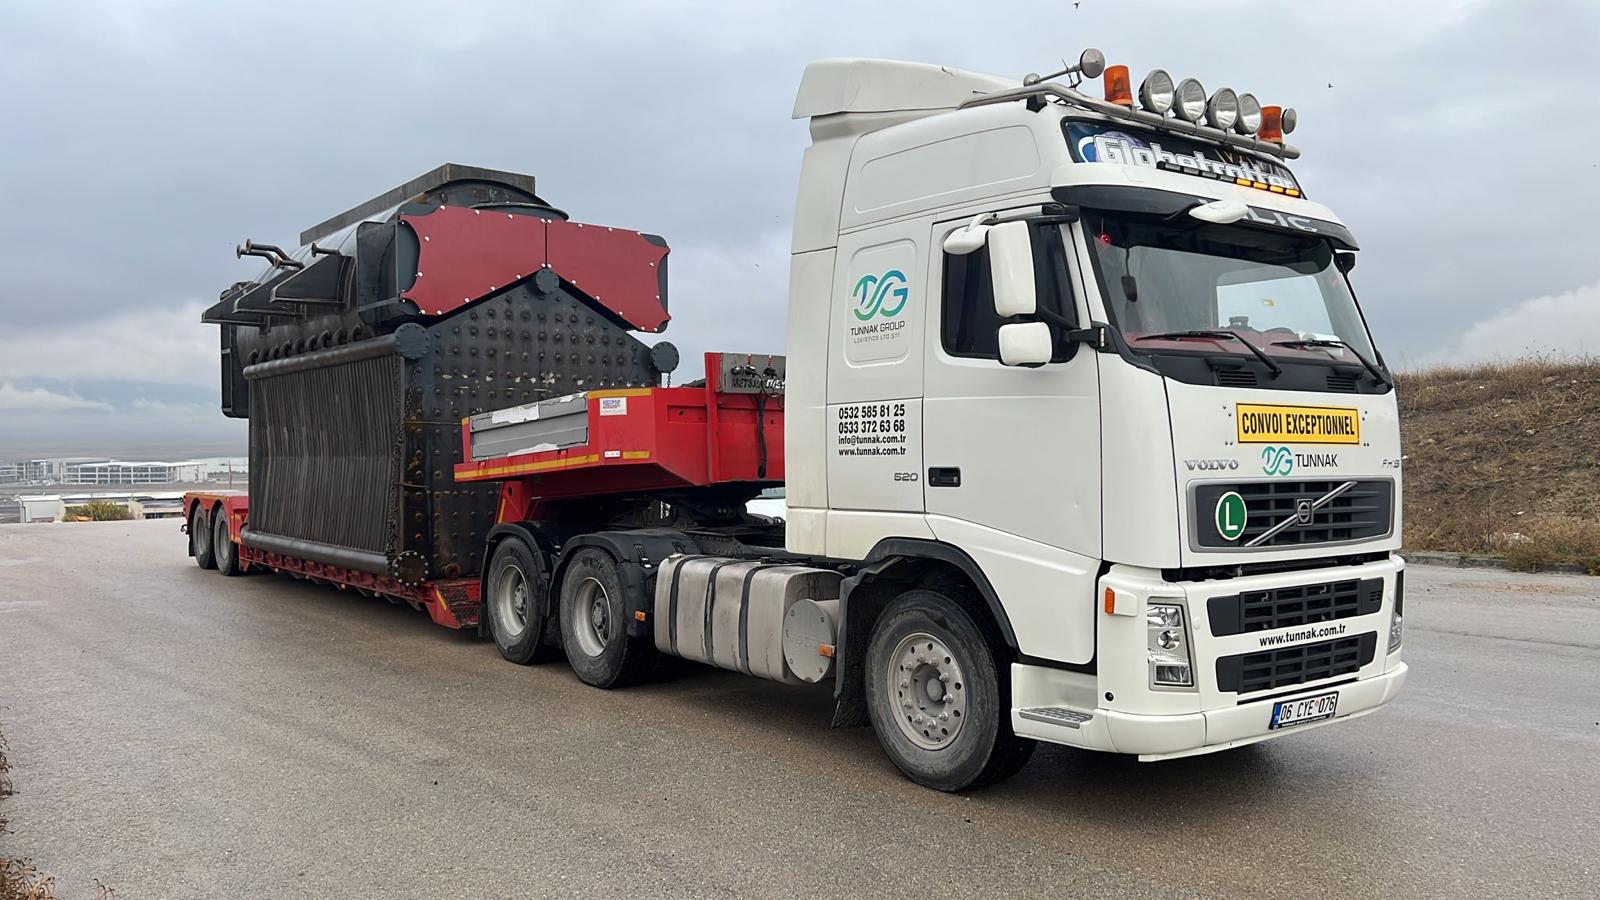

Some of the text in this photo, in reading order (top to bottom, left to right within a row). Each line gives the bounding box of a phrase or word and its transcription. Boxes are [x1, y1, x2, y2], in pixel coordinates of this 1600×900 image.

[850, 320, 905, 336] TUNNAK GROUP
[838, 403, 905, 419] 0532 585 81 25
[838, 419, 905, 434] 0533 372 63 68
[1242, 412, 1355, 435] CONVOI EXCEPTIONNEL
[838, 433, 906, 446] info@tunnak.com.tr
[838, 446, 906, 456] www.tunnak.com.tr
[1184, 458, 1239, 471] VOLVO
[1295, 453, 1338, 468] TUNNAK
[893, 472, 919, 482] 520
[1225, 501, 1239, 532] L
[1259, 623, 1346, 647] www.tunnak.com.tr
[1280, 704, 1293, 721] 06
[1297, 699, 1315, 717] CYE
[1318, 695, 1336, 714] 076
